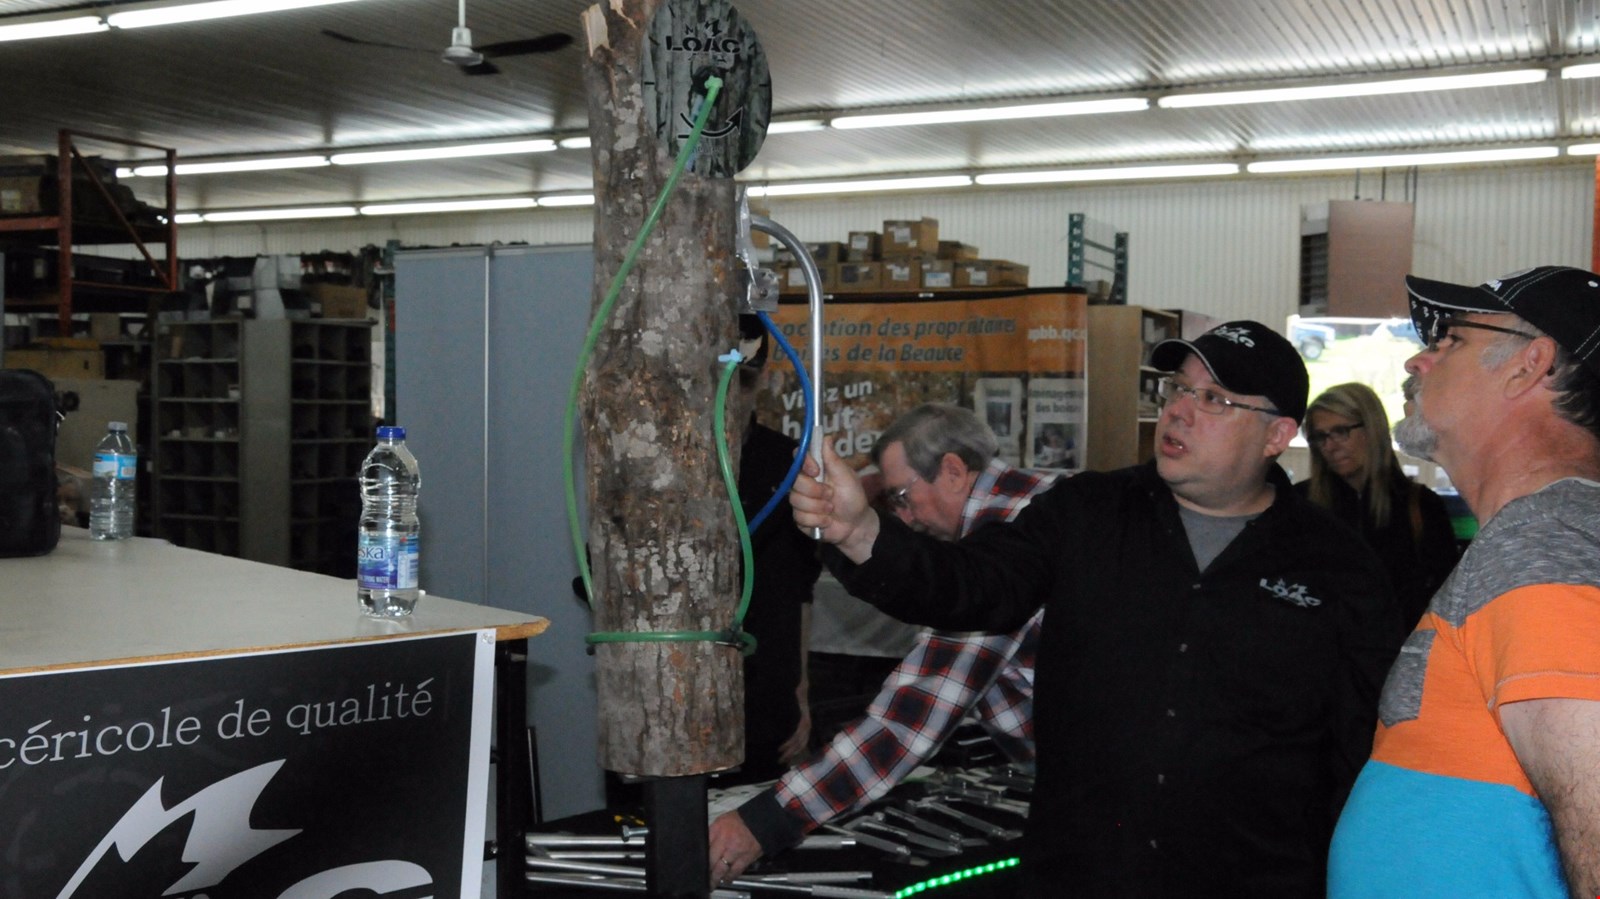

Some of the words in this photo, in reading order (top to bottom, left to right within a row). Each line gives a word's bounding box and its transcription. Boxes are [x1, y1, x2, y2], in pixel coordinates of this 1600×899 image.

[877, 318, 910, 337] des
[846, 343, 873, 362] de
[878, 343, 896, 362] la
[844, 380, 873, 399] un
[217, 698, 271, 741] de
[286, 677, 435, 736] qualité
